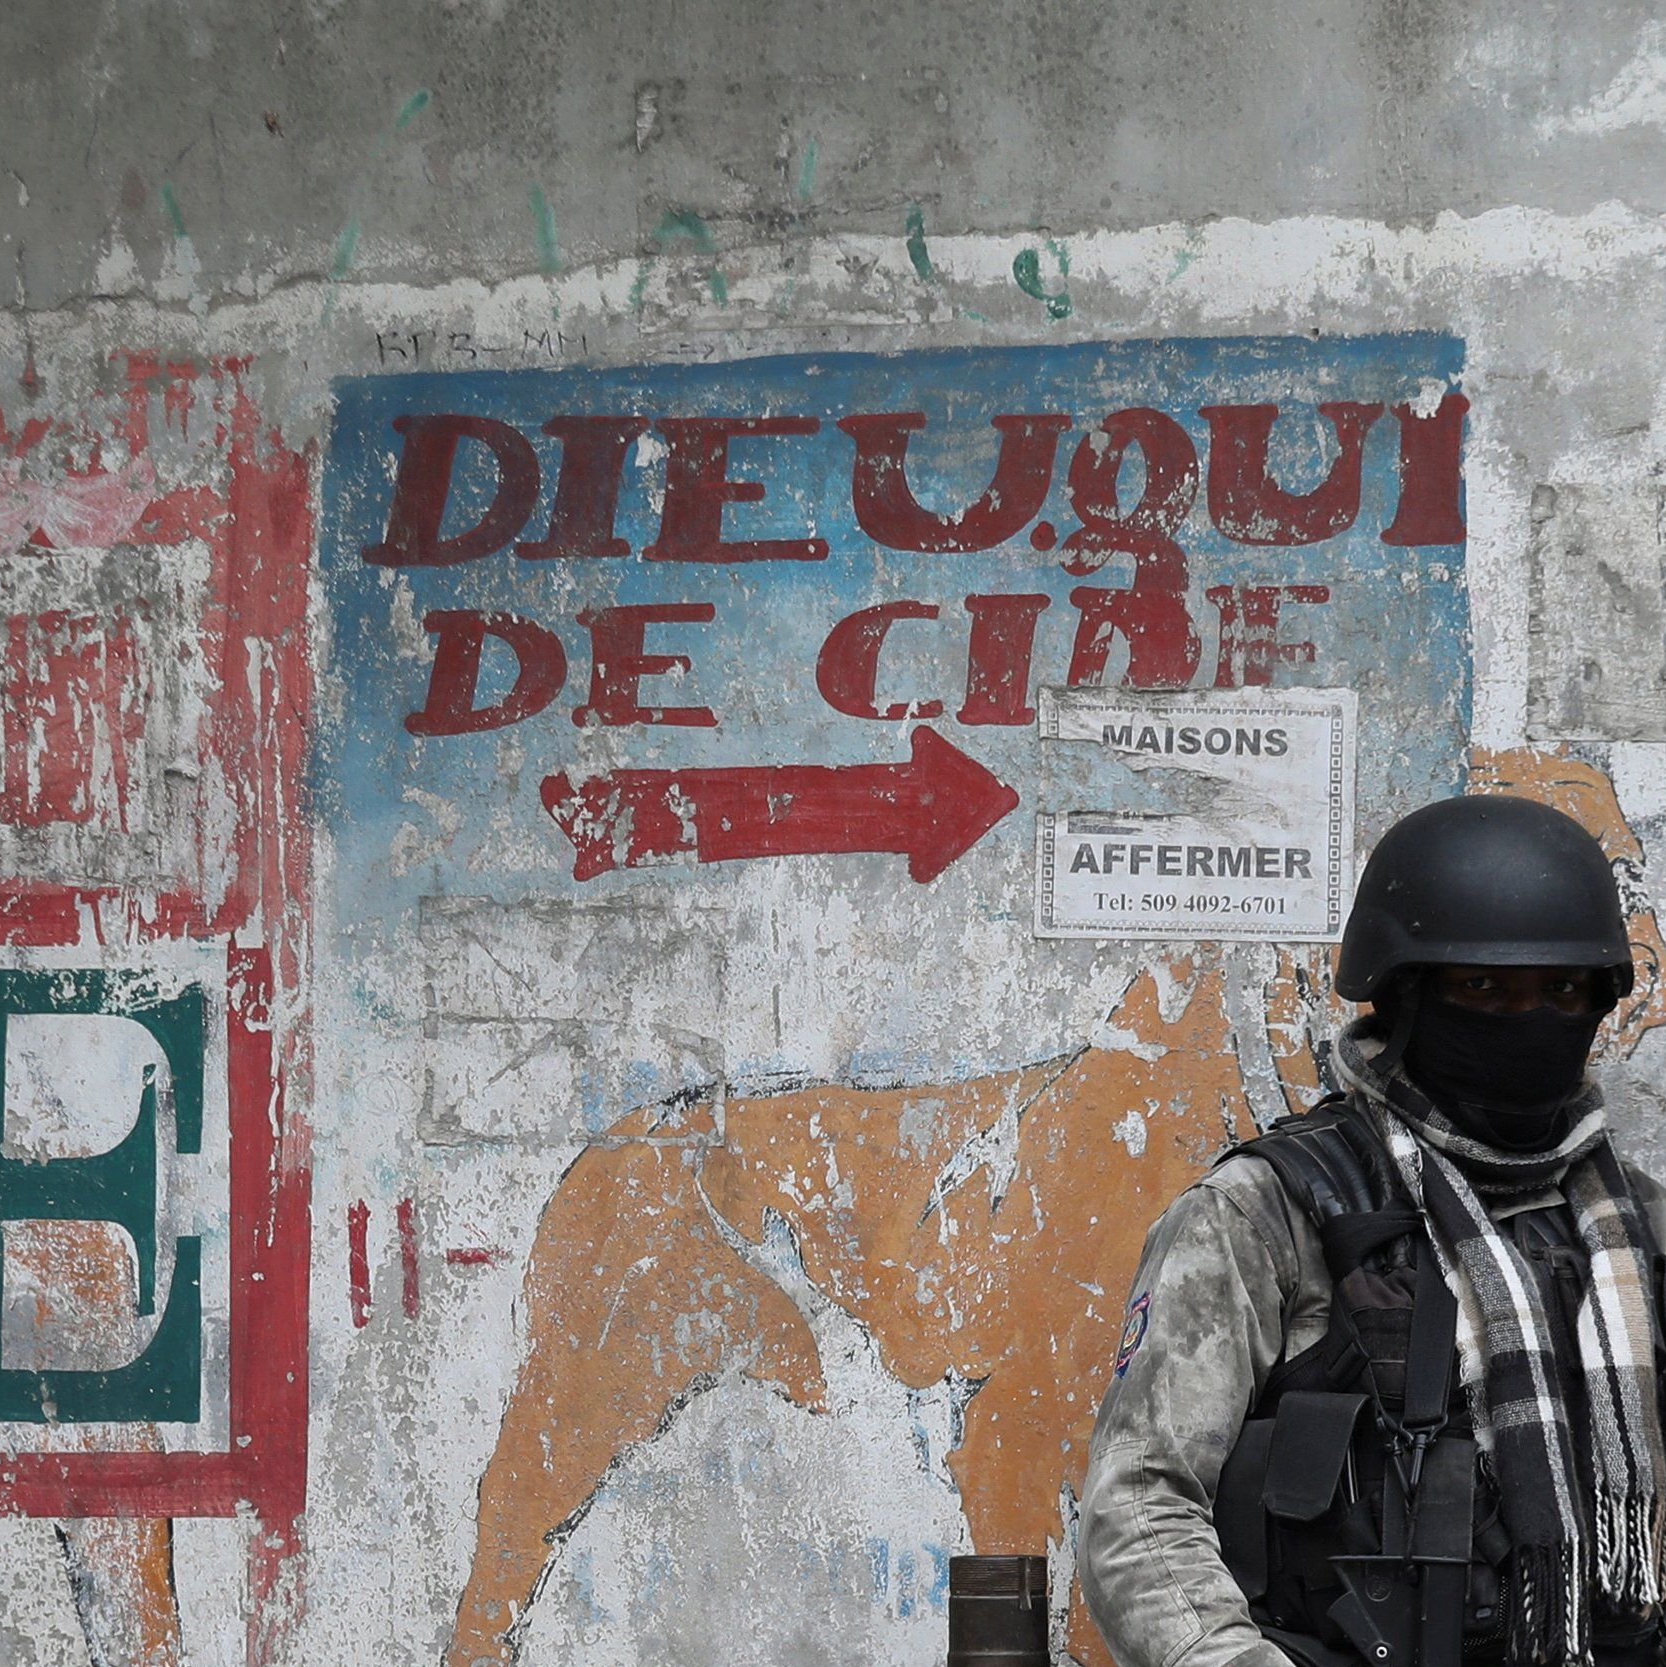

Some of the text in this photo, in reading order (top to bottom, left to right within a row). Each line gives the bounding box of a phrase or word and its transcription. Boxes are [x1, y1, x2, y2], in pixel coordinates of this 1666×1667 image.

[405, 602, 720, 737] DE
[1102, 724, 1289, 757] MAISONS
[1068, 842, 1314, 880] AFFERMER
[1093, 892, 1287, 916] Tel: 509 4092-6701
